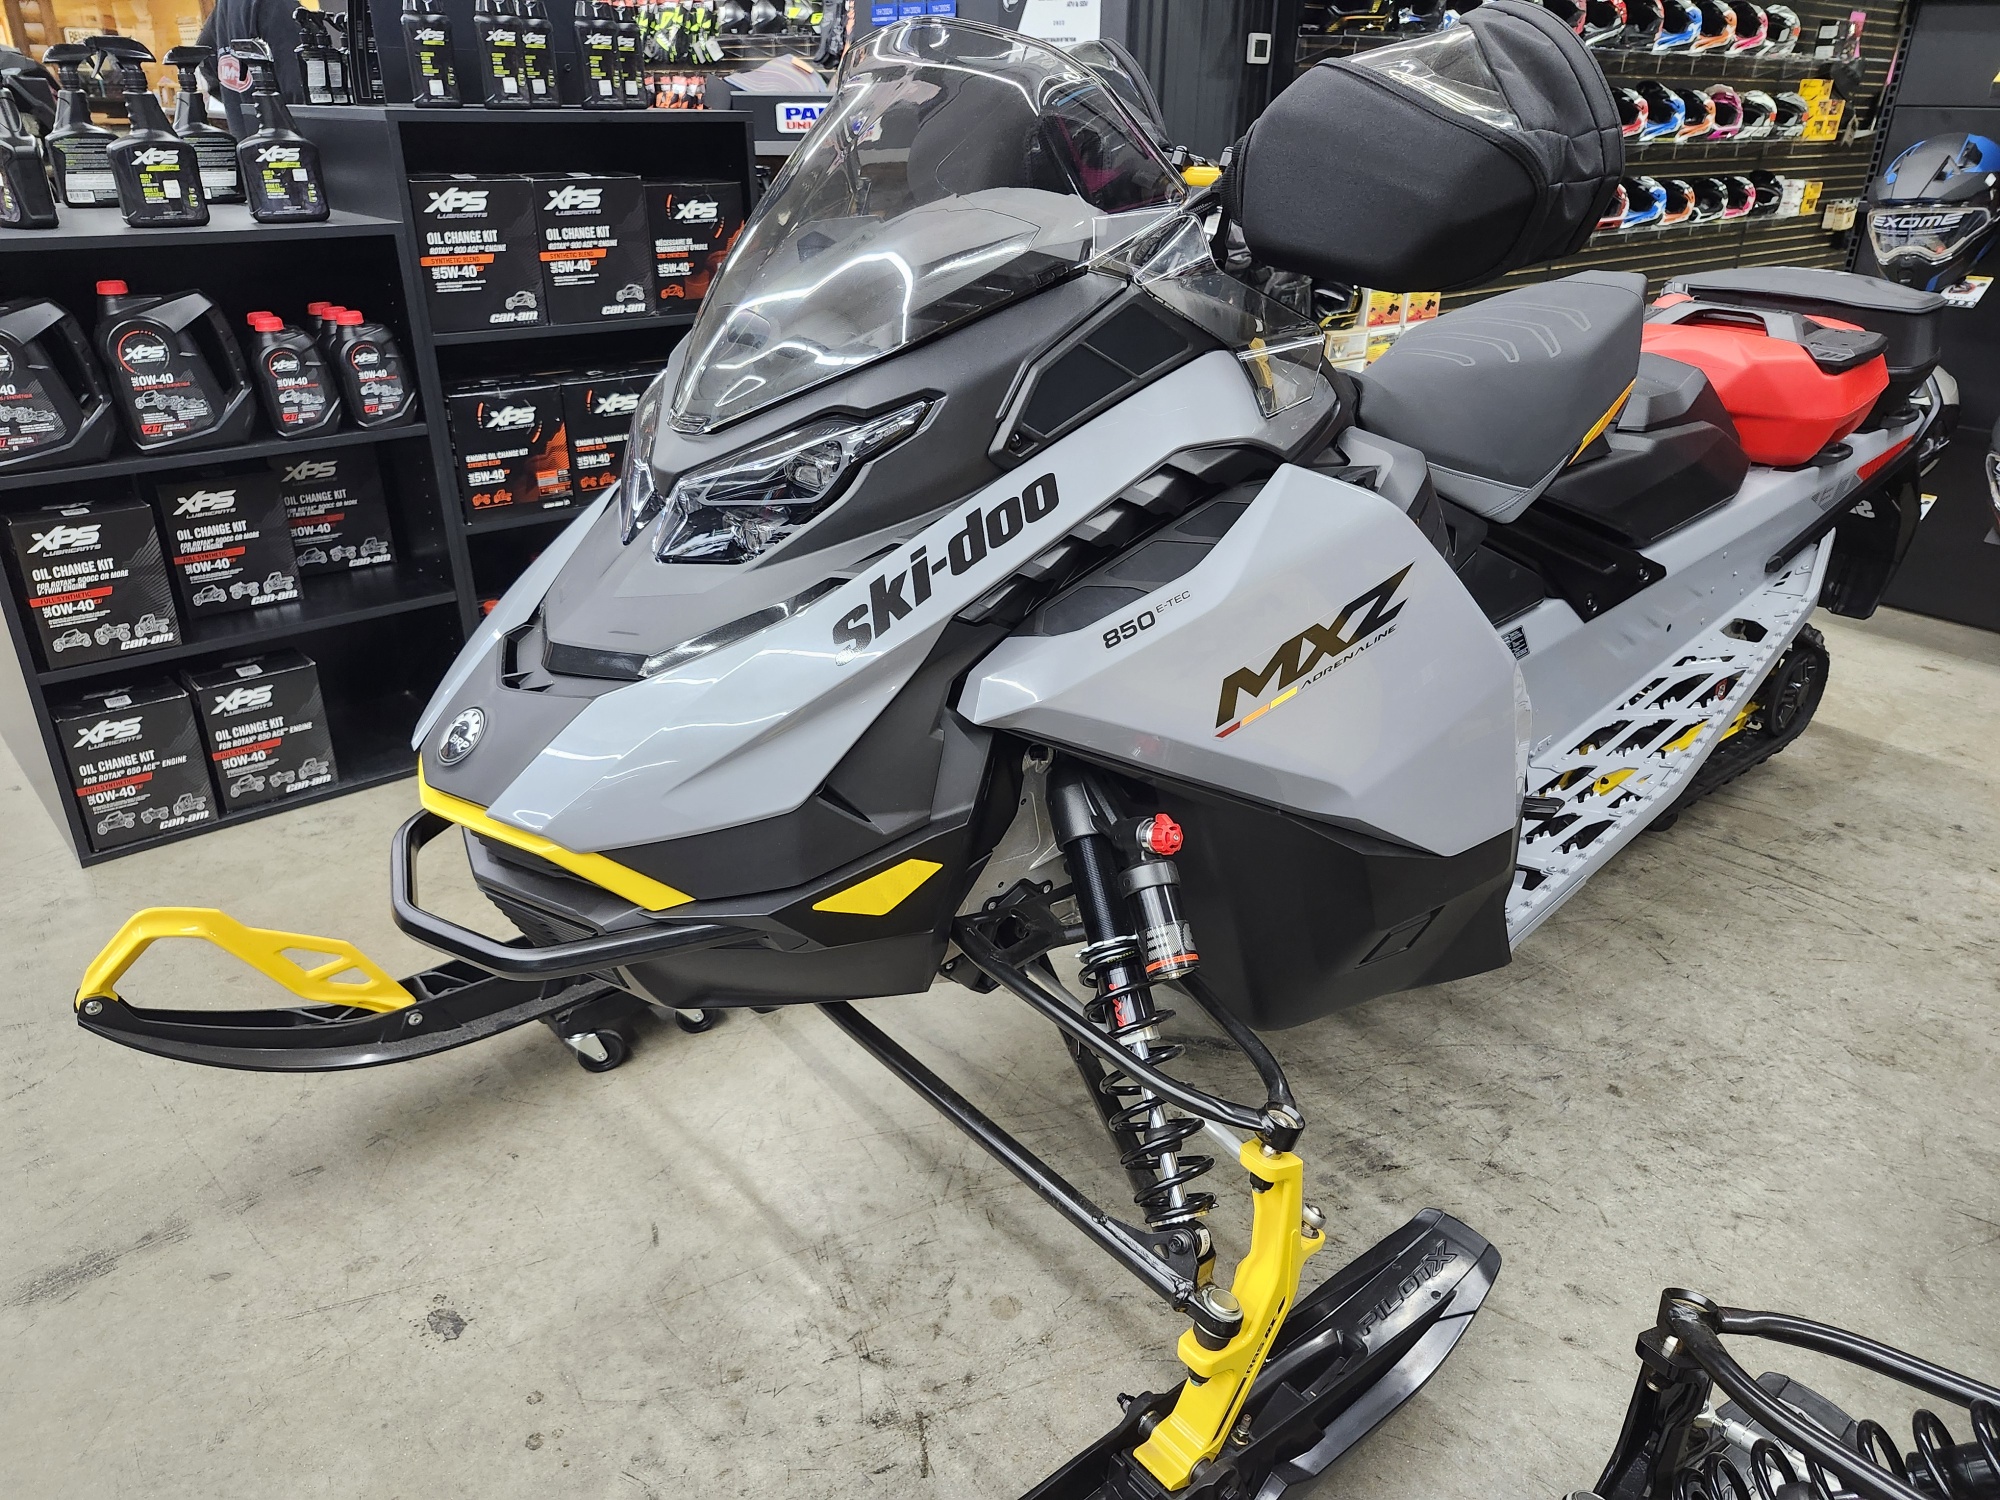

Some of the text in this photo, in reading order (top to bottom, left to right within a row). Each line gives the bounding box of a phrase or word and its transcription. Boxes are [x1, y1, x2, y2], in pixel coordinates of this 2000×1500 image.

[414, 28, 444, 40] XPS
[486, 29, 516, 41] XPS
[584, 33, 612, 45] XPS
[131, 148, 179, 165] XPS
[256, 146, 300, 162] XPS
[424, 187, 489, 213] XPS
[544, 186, 603, 210] XPS
[673, 200, 718, 219] XPS
[1874, 213, 1964, 228] EXOME
[427, 230, 498, 245] OIL CHANGE KIT
[546, 226, 610, 241] OIL CHANGE KIT
[440, 265, 477, 279] 5W-40
[558, 259, 591, 273] 5W-40
[664, 262, 689, 272] 5W-40
[123, 344, 165, 360] XPS
[354, 353, 378, 364] XPS
[272, 360, 298, 370] XPS
[139, 373, 173, 386] 0W-40
[283, 377, 308, 386] 0W-40
[364, 369, 387, 379] 0W-40
[594, 393, 640, 413] XPS
[486, 406, 536, 428] XPS
[584, 453, 610, 465] 5W-40
[281, 461, 338, 482] XPS
[476, 469, 505, 482] 5W-40
[173, 489, 236, 516] XPS
[284, 489, 347, 506] OIL CHANGE KIT
[176, 520, 247, 541] OIL CHANGE KIT
[297, 523, 331, 537] 0W-40
[27, 524, 102, 554] XPS
[43, 544, 101, 558] LUBRICANTS
[198, 551, 227, 560] SYNTHETIC
[32, 558, 114, 582] OIL CHANGE KIT
[193, 558, 230, 573] 0W-40
[832, 472, 1059, 666] ski-doo
[110, 570, 129, 579] MORE
[58, 591, 91, 602] SYNTHETIC
[52, 599, 94, 616] 0W-40
[1102, 590, 1191, 649] 850 E-TEC
[1215, 560, 1416, 728] MXZ
[1301, 624, 1397, 689] ADRENALINE
[210, 684, 274, 716] XPS
[73, 716, 143, 748] XPS
[215, 716, 284, 742] OIL CHANGE KIT
[88, 734, 143, 751] LUBRICANTS
[218, 742, 232, 751] FOR
[449, 734, 469, 749] BRP
[79, 749, 156, 777] OIL CHANGE KIT
[230, 750, 266, 768] 0W-40
[83, 777, 97, 786] FOR
[162, 755, 188, 768] ENGINE
[101, 778, 133, 790] SYNTHETIC
[96, 784, 136, 804] 0W-40
